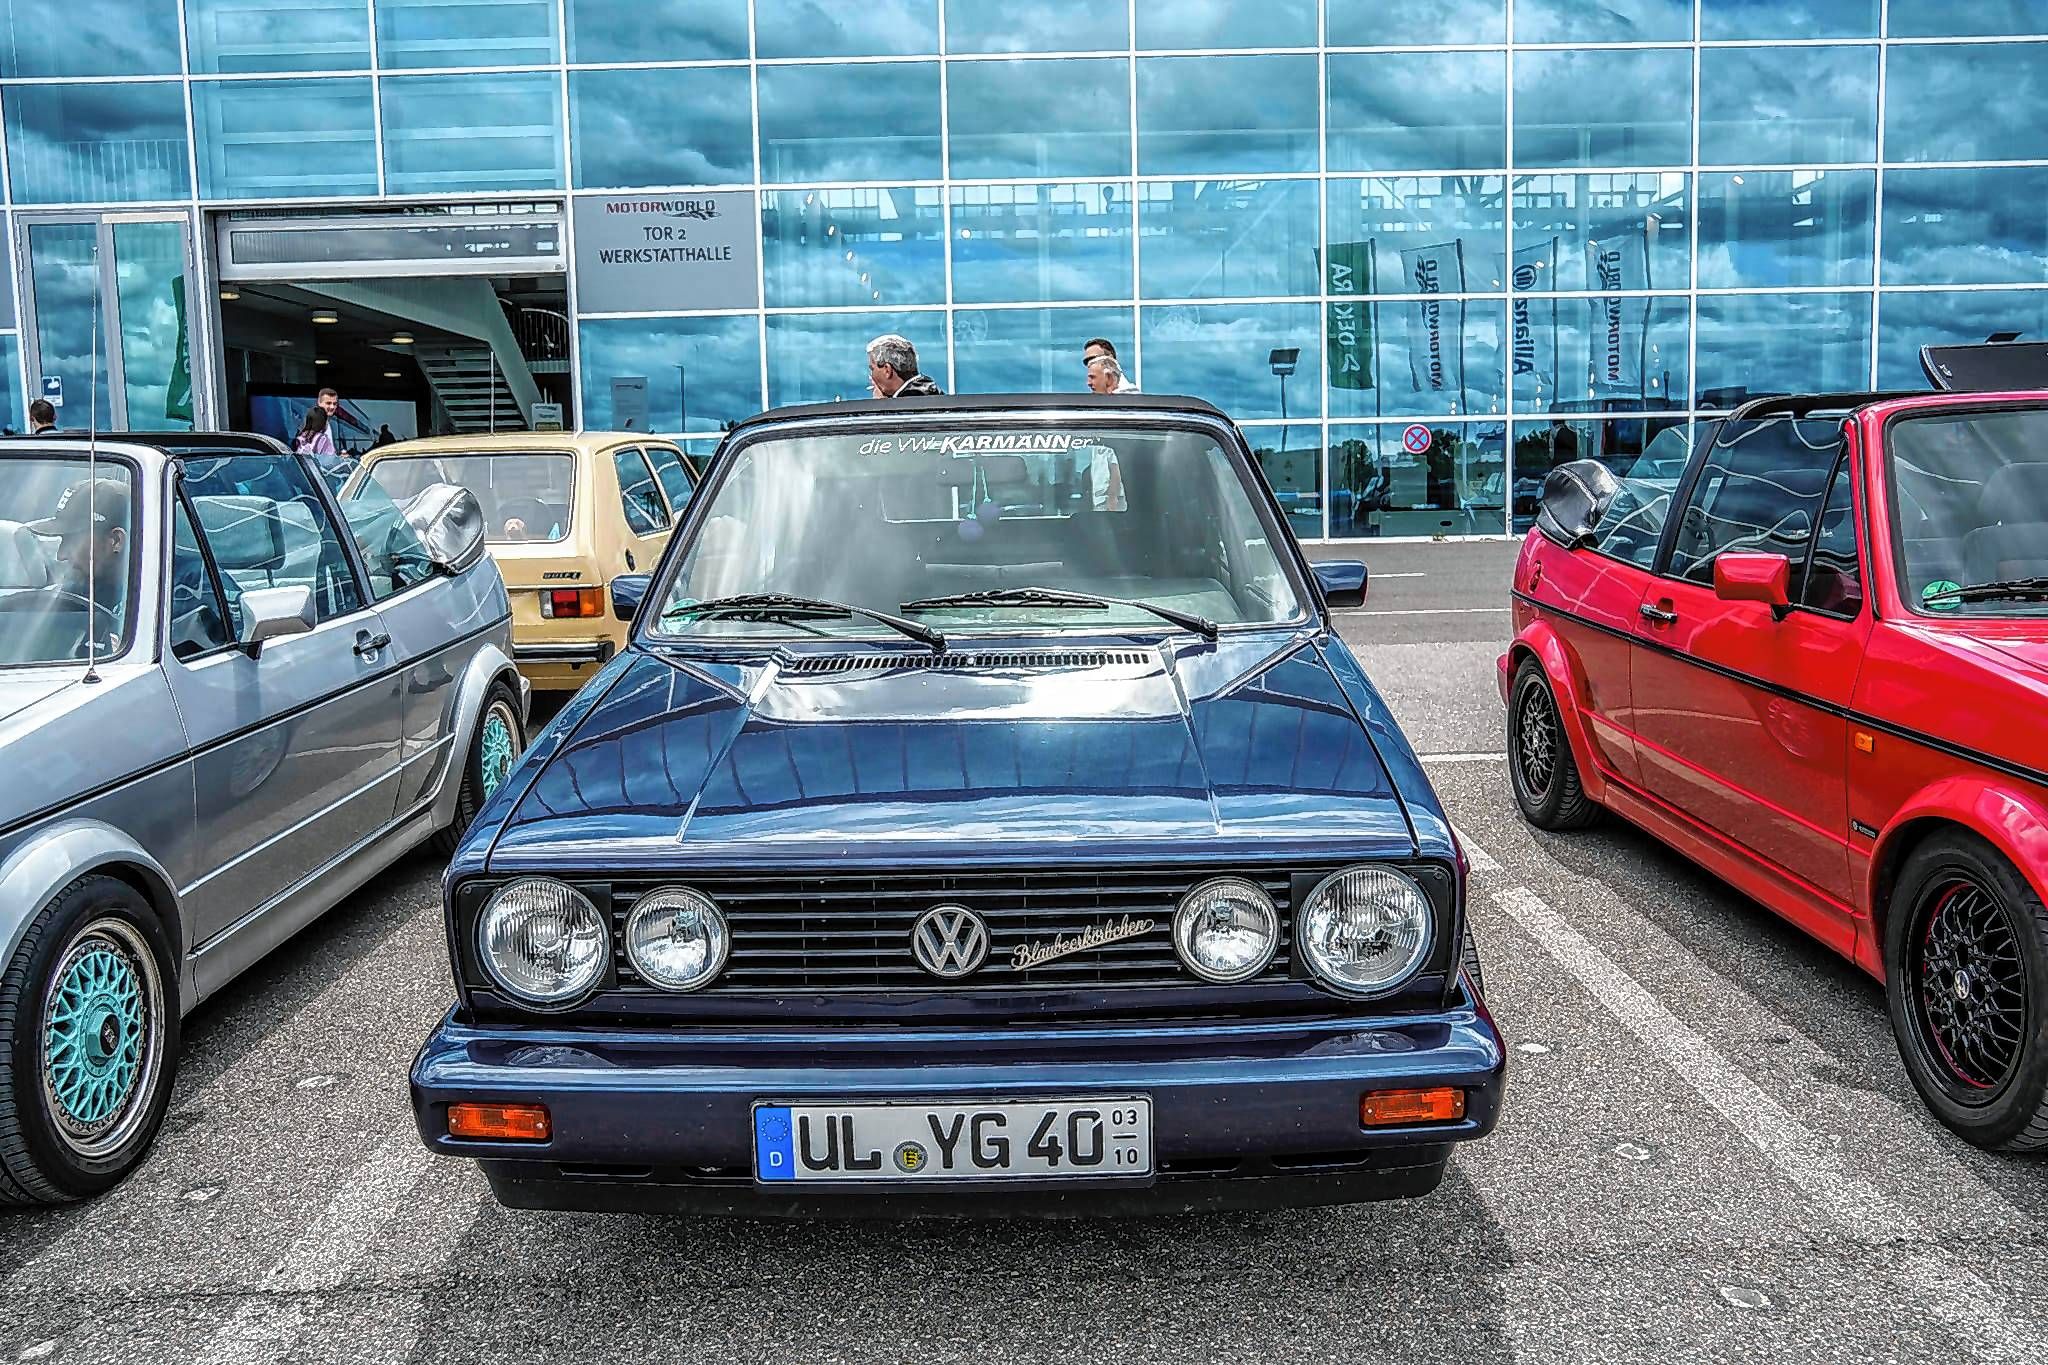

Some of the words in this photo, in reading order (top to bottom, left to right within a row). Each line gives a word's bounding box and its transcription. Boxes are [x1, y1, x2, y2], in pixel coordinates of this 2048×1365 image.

[606, 200, 715, 214] MOTORWORLD
[643, 226, 673, 241] TOR
[678, 228, 687, 241] 2
[600, 246, 732, 264] WERKSTATTHALLE
[859, 439, 892, 455] die
[913, 904, 988, 977] VW
[1112, 1109, 1138, 1126] 03
[799, 1114, 882, 1172] UL
[927, 1109, 1010, 1170] YG
[1027, 1109, 1105, 1168] 40
[769, 1152, 783, 1168] D
[1114, 1147, 1138, 1165] 10
